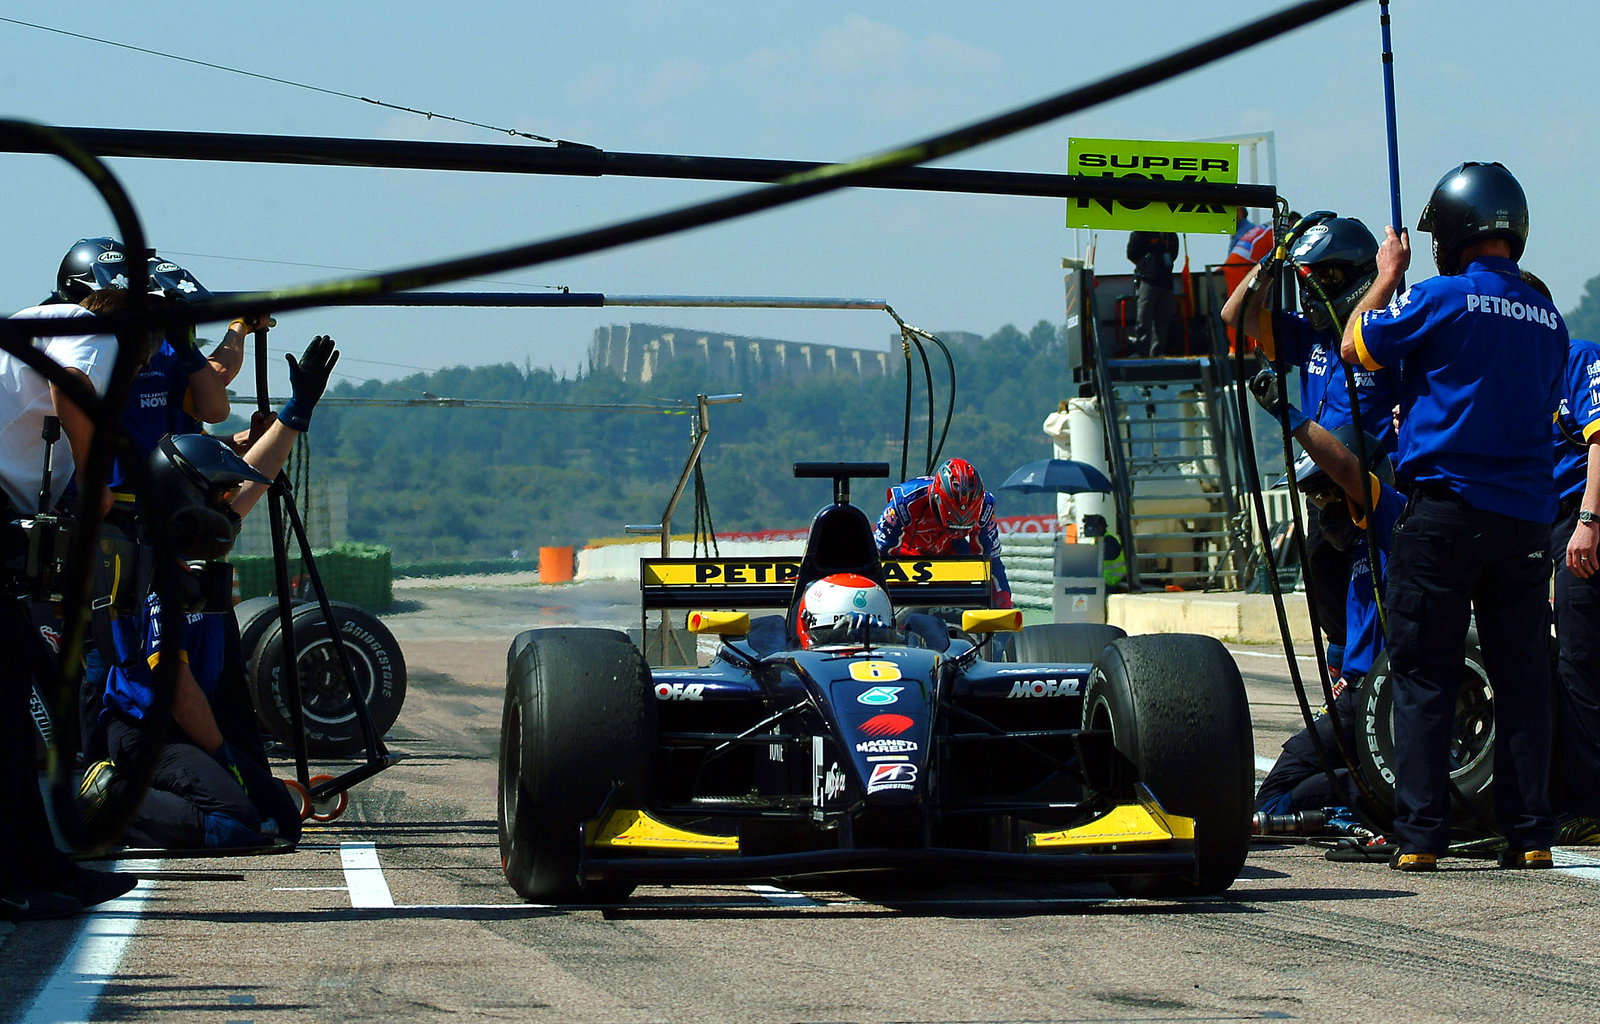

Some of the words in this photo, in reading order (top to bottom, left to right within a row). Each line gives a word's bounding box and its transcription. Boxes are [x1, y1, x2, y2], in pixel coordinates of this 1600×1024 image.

[1078, 153, 1230, 172] SUPER
[1466, 294, 1558, 330] PETRONAS
[695, 563, 933, 583] PETRAS
[341, 620, 393, 699] BRIDGESTONE
[848, 660, 902, 682] 6
[654, 682, 705, 701] OFAZ
[1007, 678, 1081, 698] MOFAZ
[1366, 675, 1396, 789] OTENZA
[856, 739, 918, 750] MAGNETI
[856, 743, 918, 752] MARELLI
